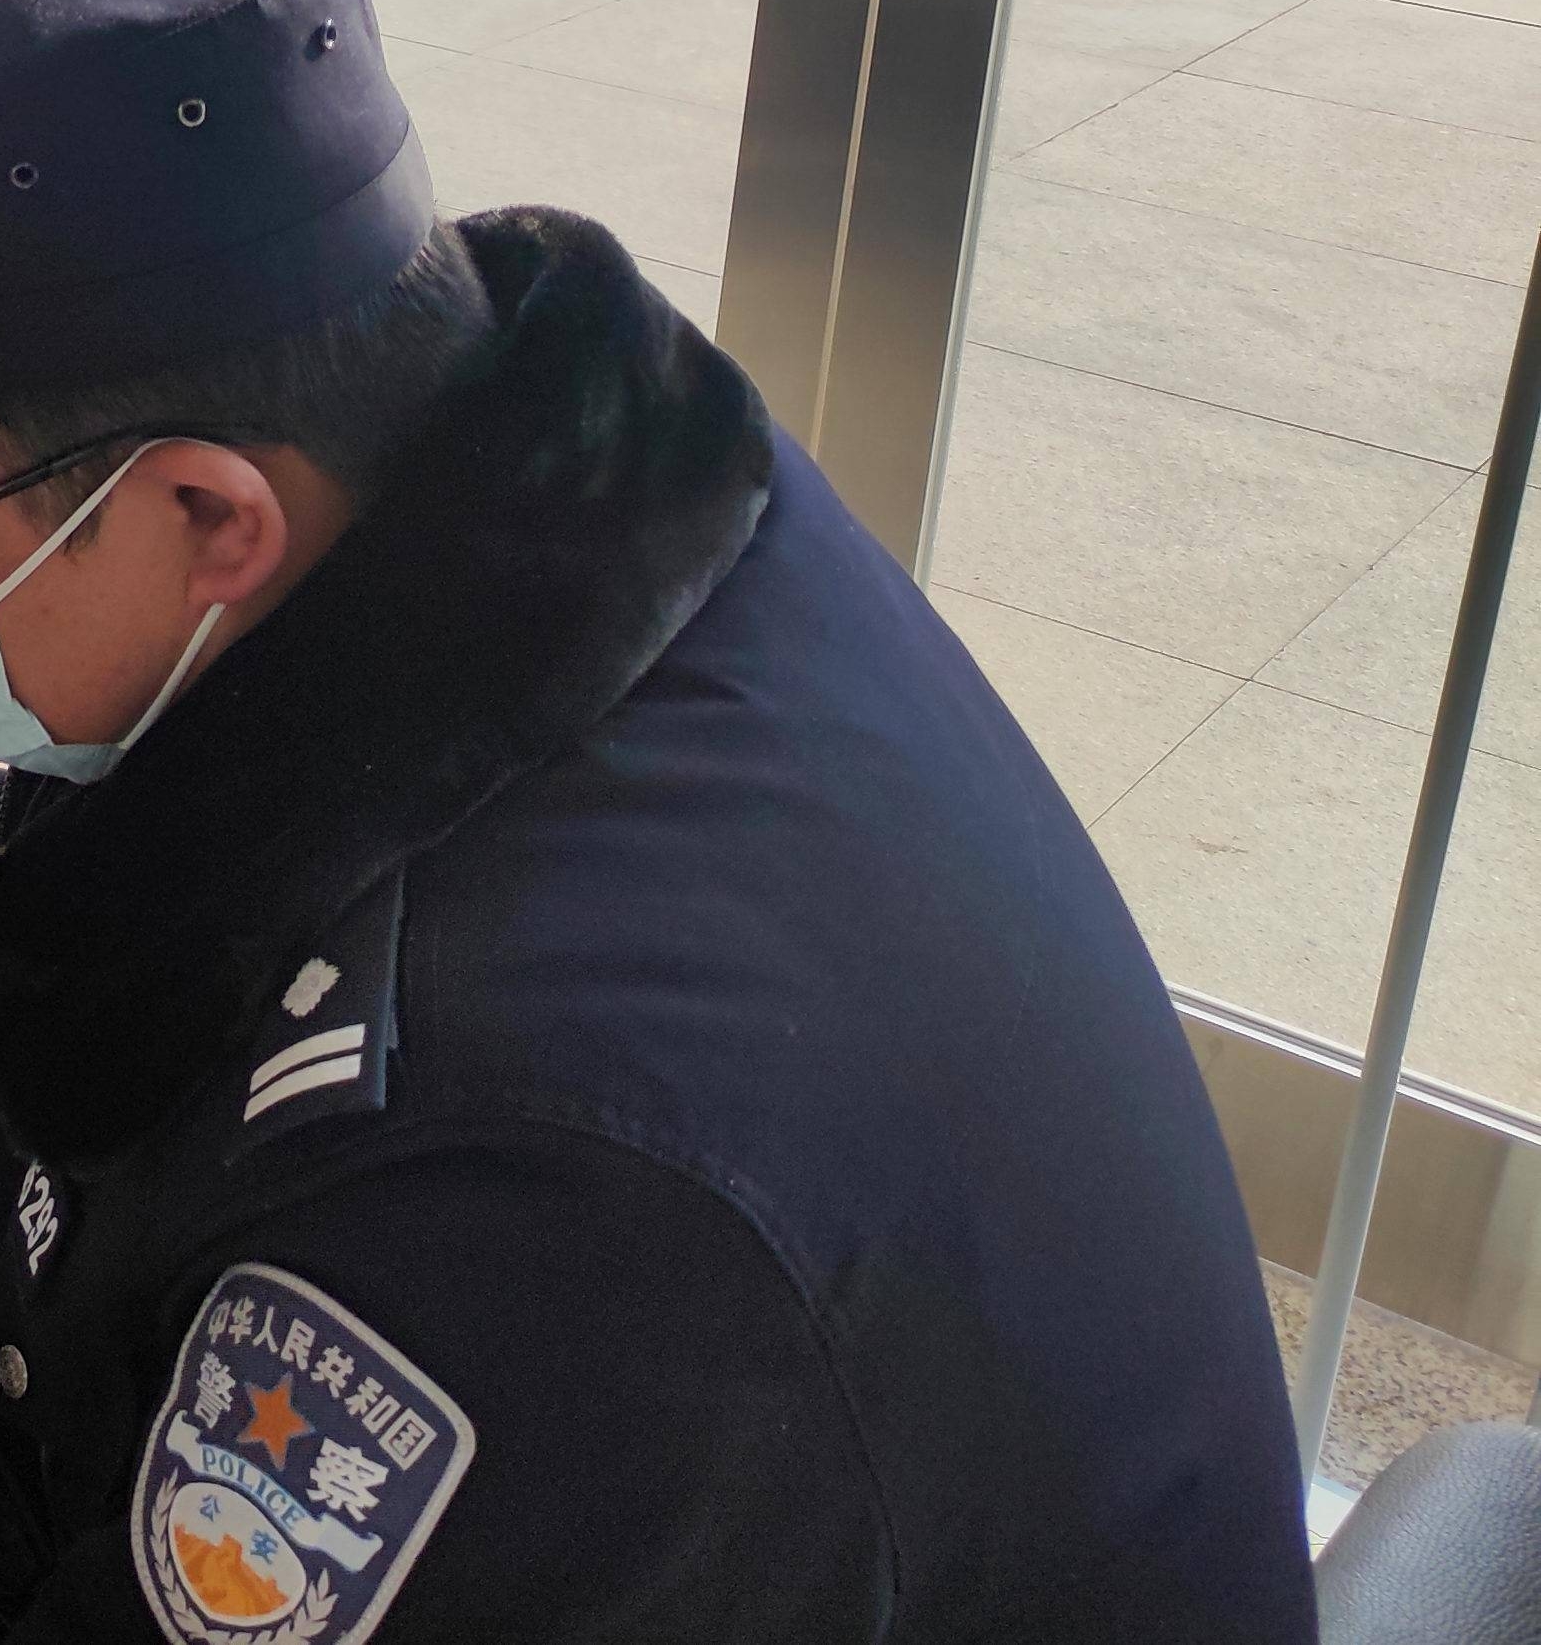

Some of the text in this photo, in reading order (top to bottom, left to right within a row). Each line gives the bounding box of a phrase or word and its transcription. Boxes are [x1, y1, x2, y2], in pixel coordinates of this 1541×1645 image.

[192, 1349, 390, 1524] 警 察
[207, 1295, 439, 1472] 中华人民共和国
[200, 1447, 306, 1533] POLICE
